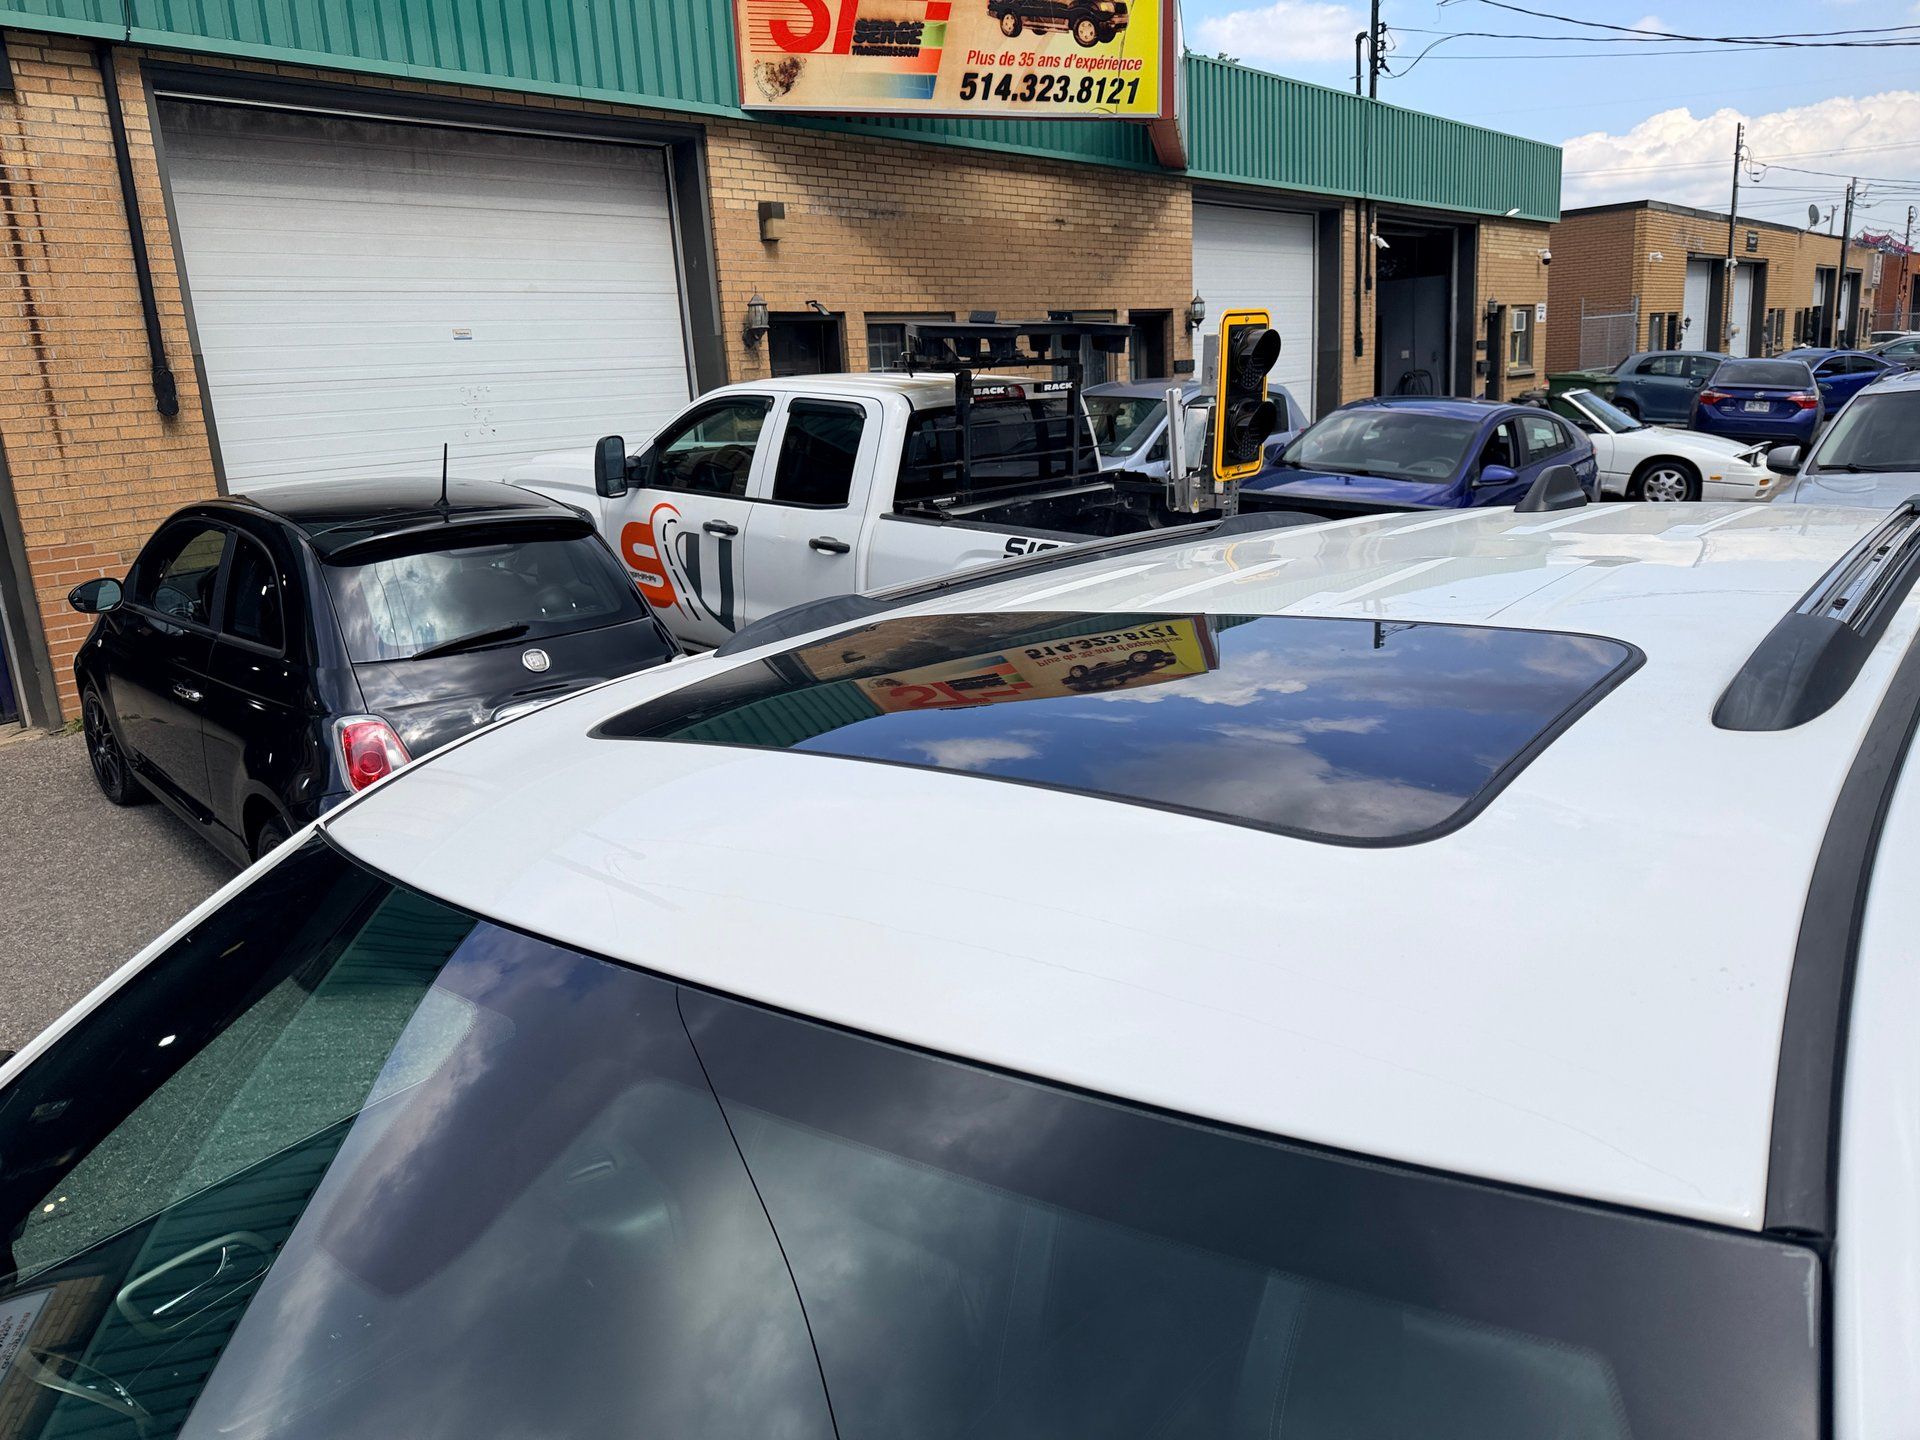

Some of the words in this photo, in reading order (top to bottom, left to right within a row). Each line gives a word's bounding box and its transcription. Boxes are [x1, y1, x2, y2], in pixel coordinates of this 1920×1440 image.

[966, 50, 996, 65] Plus
[999, 51, 1015, 66] de
[1018, 52, 1036, 67] 35
[1037, 55, 1061, 68] ans
[1064, 53, 1143, 72] d'expérience
[959, 72, 1141, 105] 514.323.8121
[1043, 381, 1074, 391] RACK
